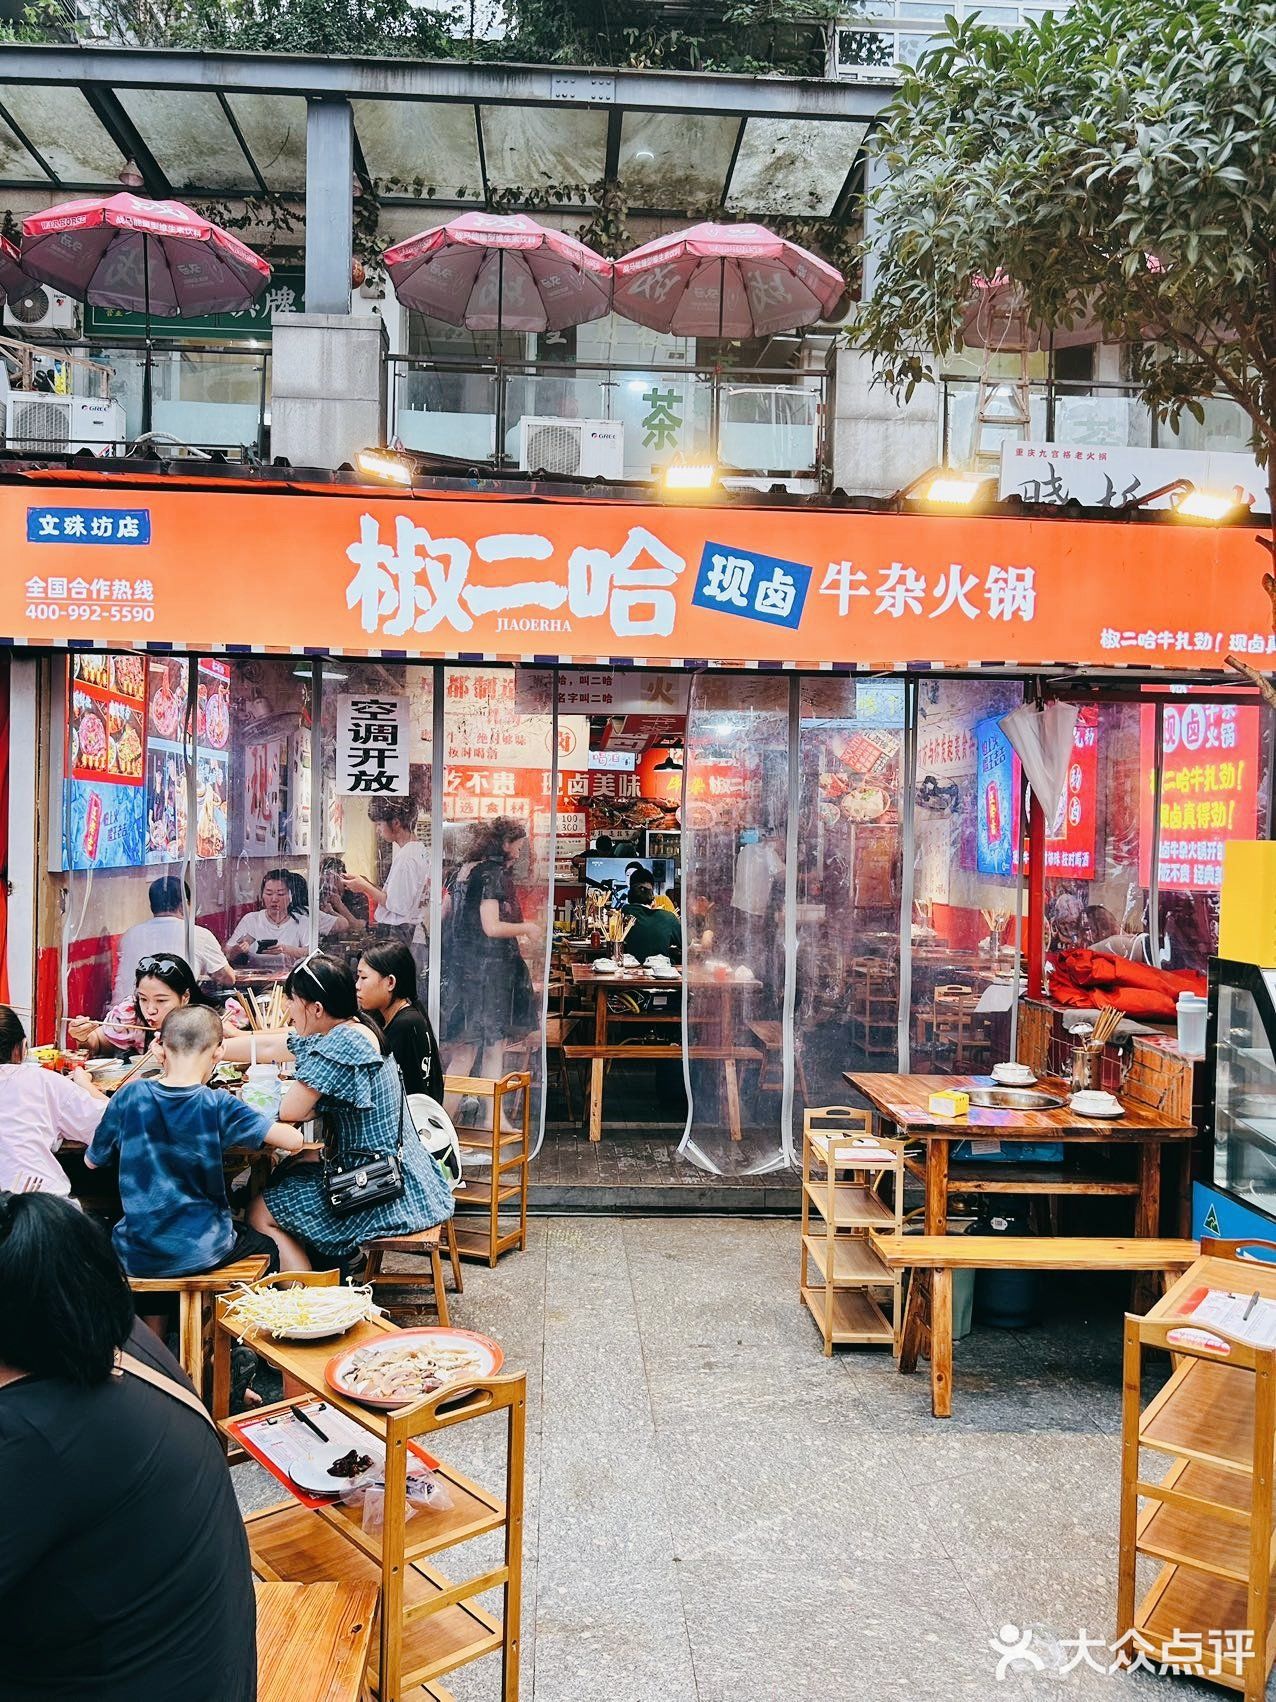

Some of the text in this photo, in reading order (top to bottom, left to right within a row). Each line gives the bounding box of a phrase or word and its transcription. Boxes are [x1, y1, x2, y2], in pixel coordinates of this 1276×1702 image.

[641, 387, 683, 451] 茶
[1015, 447, 1108, 461] 重庆九宫格老火锅
[39, 513, 140, 538] 文殊坊店
[346, 512, 687, 637] 椒二哈
[704, 552, 798, 618] 现卤
[25, 576, 154, 601] 全国合作热线
[818, 560, 1038, 622] 牛杂火锅
[25, 603, 155, 623] 400-992-5590
[495, 616, 572, 633] JIAOERHA
[346, 698, 400, 793] 空调开放
[541, 772, 642, 798] 现卤美味
